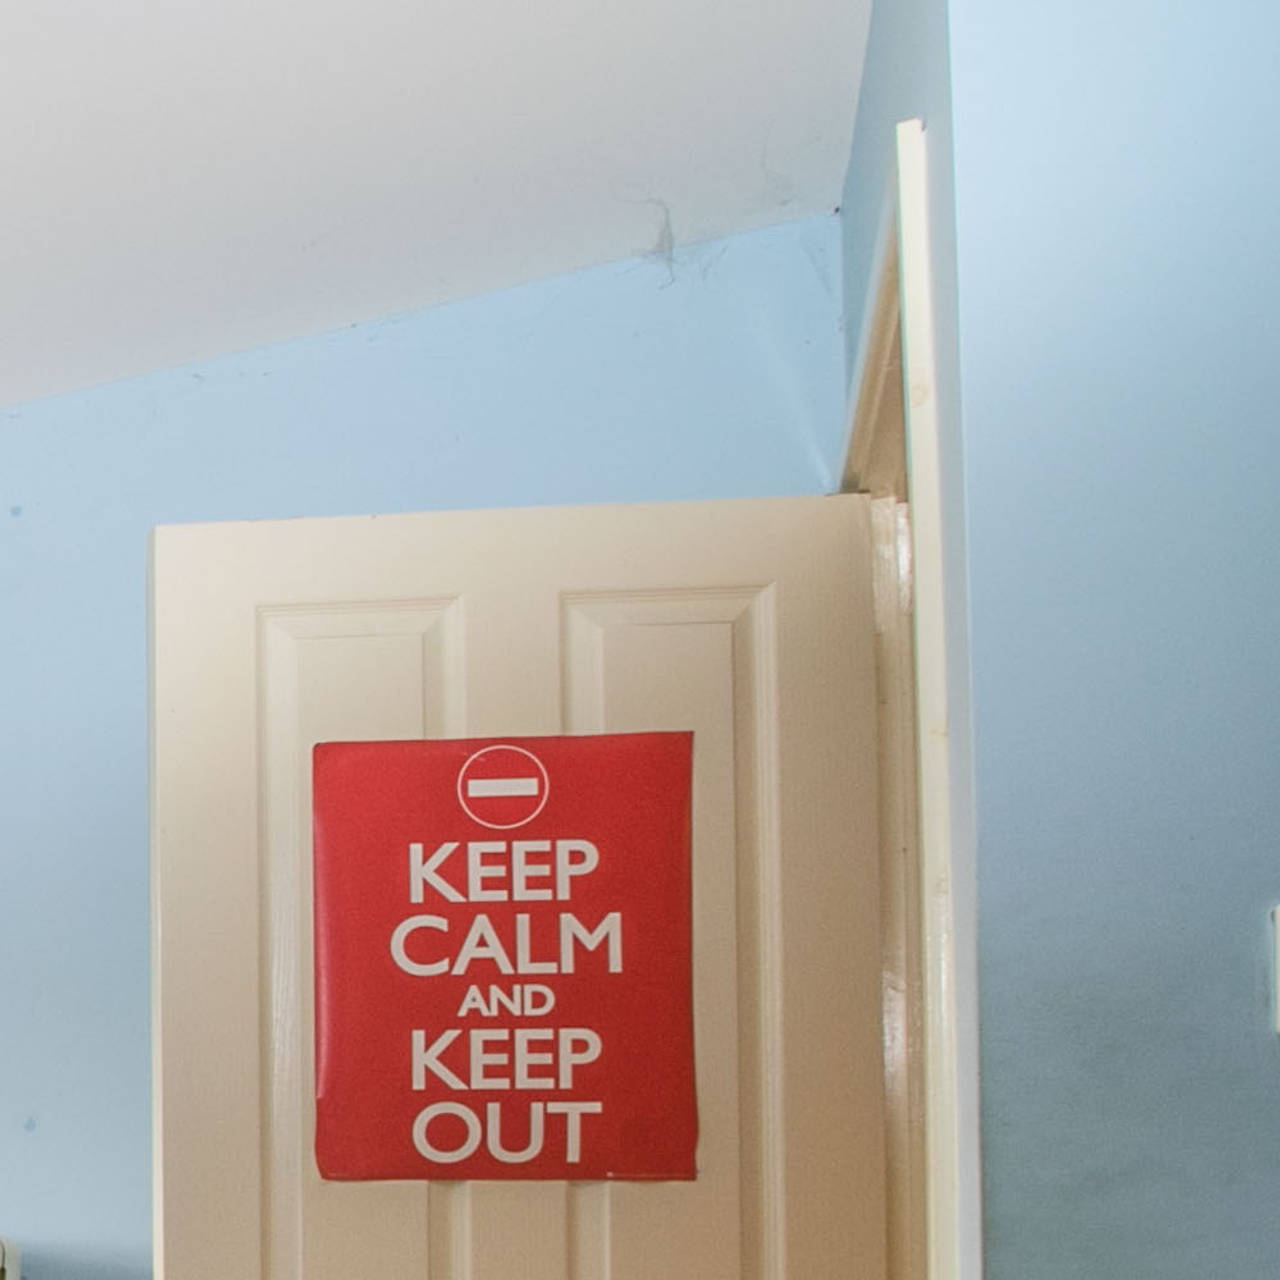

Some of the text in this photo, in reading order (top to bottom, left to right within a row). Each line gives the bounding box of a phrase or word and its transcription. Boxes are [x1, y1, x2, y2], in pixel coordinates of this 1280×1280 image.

[409, 839, 600, 903] KEEP
[390, 911, 623, 976] CALM
[457, 983, 556, 1017] AND
[410, 1027, 602, 1091] KEEP
[412, 1101, 603, 1164] OUT
